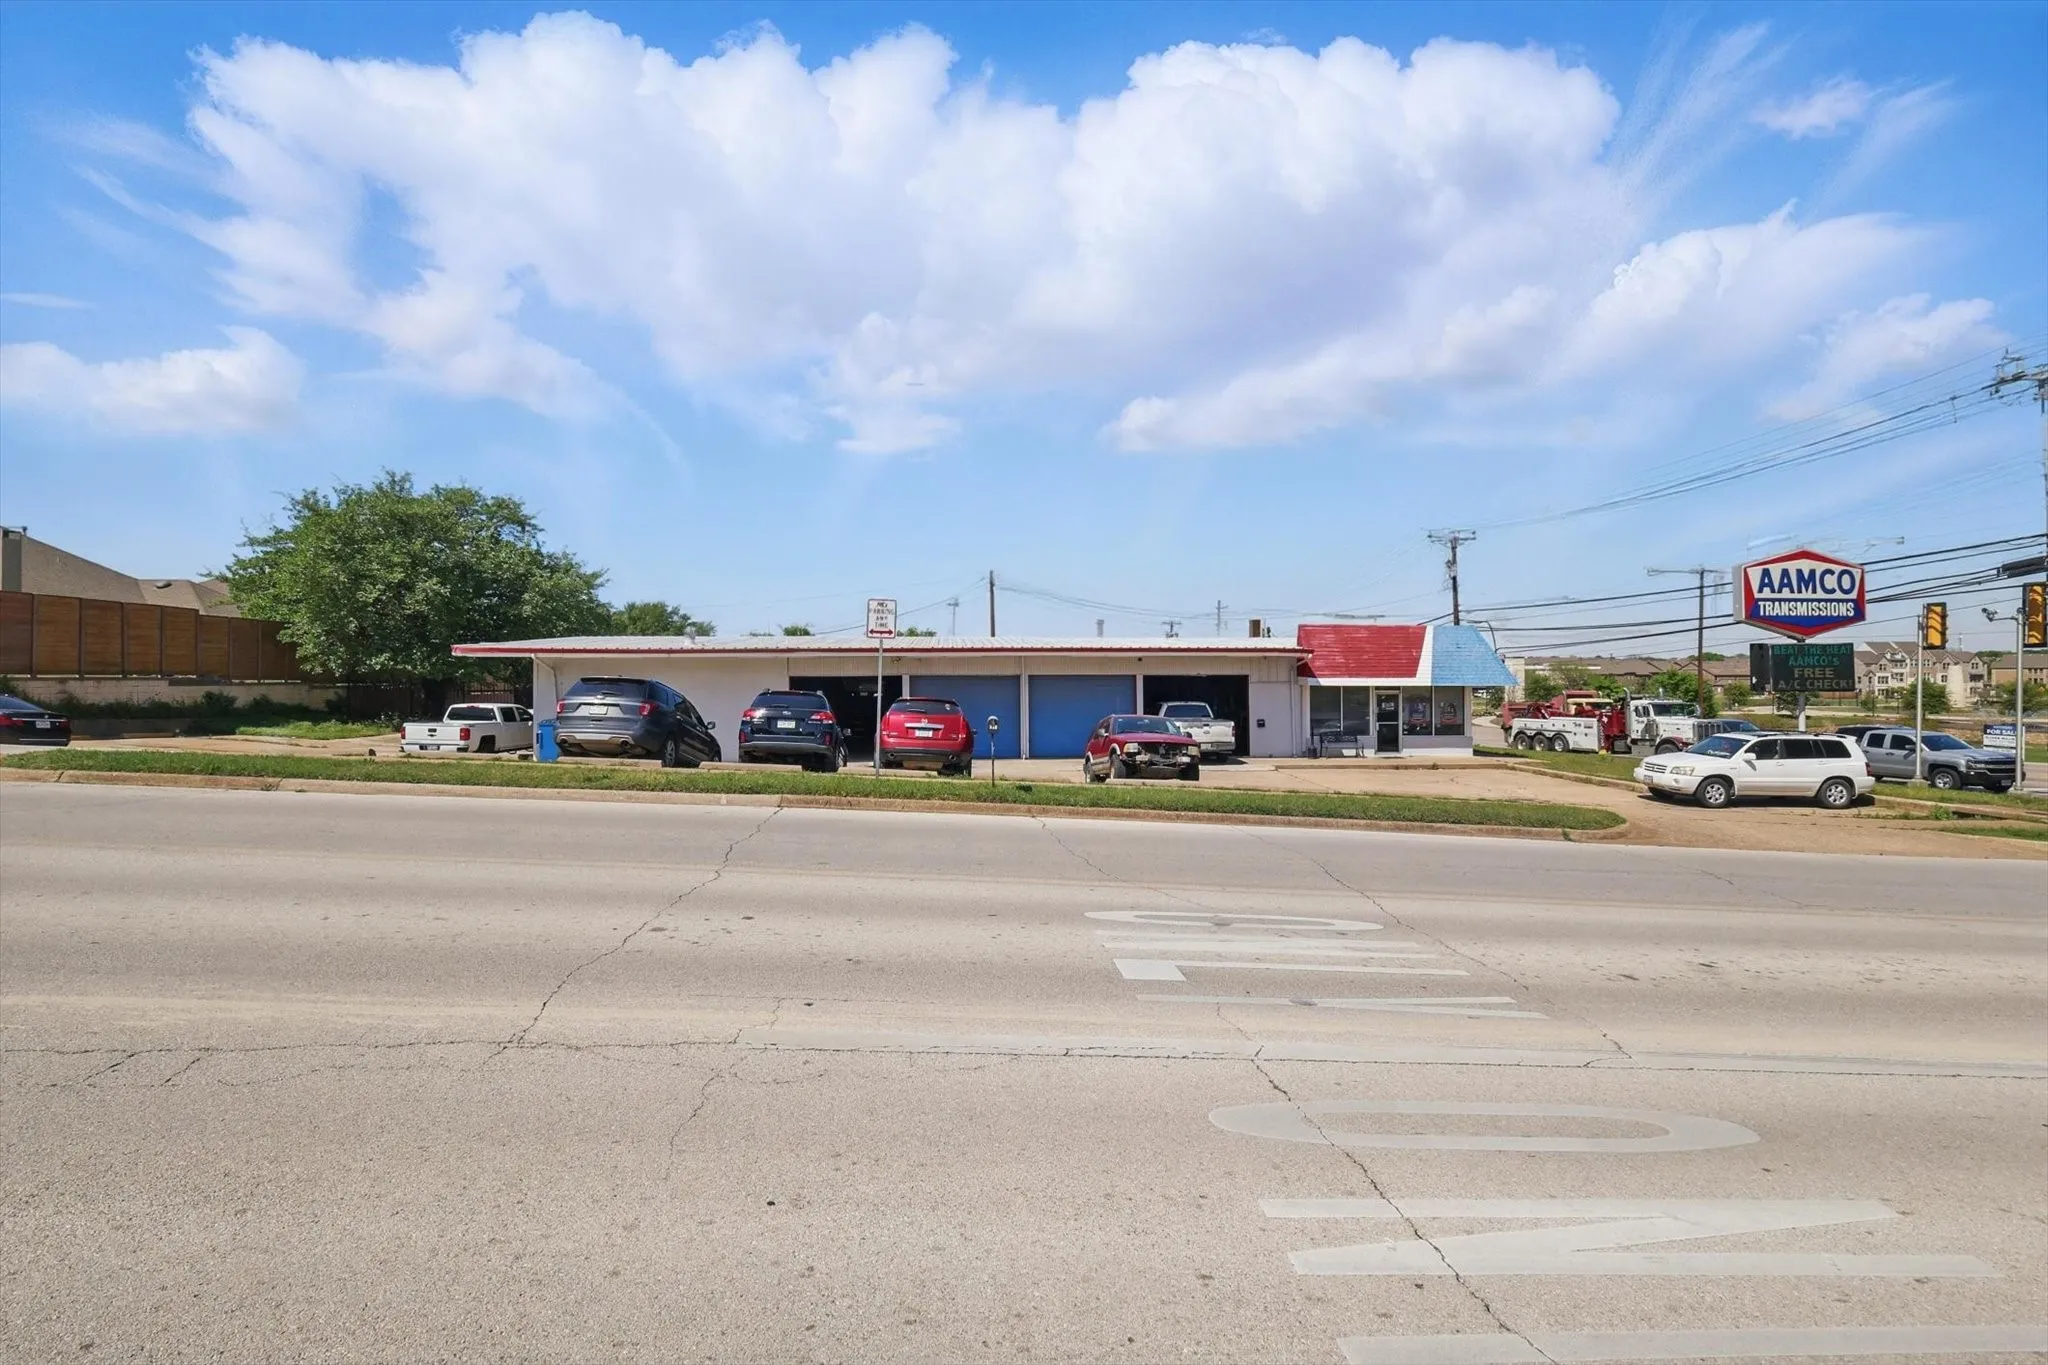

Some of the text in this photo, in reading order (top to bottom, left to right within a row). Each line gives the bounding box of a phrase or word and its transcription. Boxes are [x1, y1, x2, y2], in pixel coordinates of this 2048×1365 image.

[1757, 568, 1856, 595] AAMCO
[1758, 601, 1854, 616] TRANSMISSIONS
[1773, 645, 1851, 655] BEAT THE HEAT
[1794, 667, 1835, 678] FREE
[1778, 679, 1853, 690] A/C CHECK!
[1085, 910, 1547, 1020] ONLY
